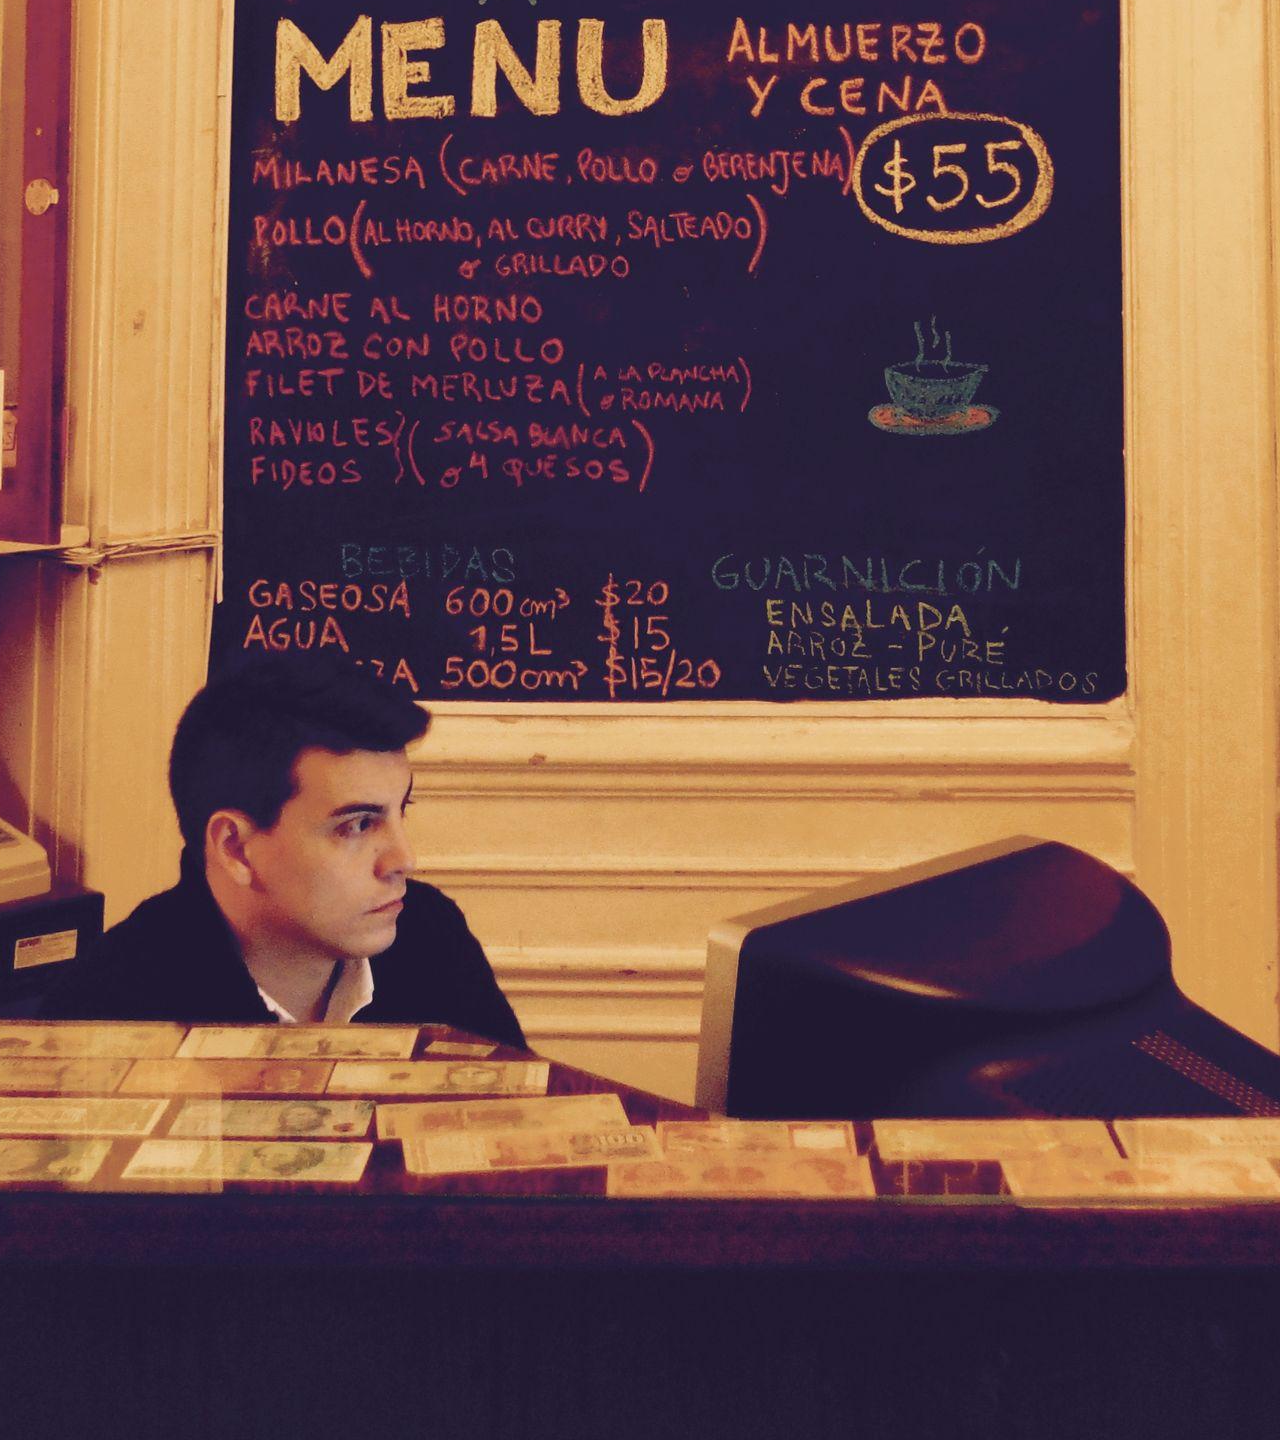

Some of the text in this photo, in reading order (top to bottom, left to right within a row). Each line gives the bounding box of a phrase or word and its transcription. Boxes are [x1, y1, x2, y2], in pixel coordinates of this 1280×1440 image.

[727, 16, 986, 64] ALMUERZO
[275, 14, 668, 123] MENU
[746, 75, 948, 118] Y CENA
[253, 155, 426, 190] MILANESA
[577, 147, 658, 184] POLLO
[874, 139, 1024, 214] $55
[254, 215, 347, 246] POLLO
[488, 218, 519, 241] AL
[495, 252, 630, 278] GRILLADO
[244, 293, 544, 325] CARNE AL HORNO
[246, 332, 565, 363] ARROZ CON POLLO
[246, 368, 345, 398] FILET
[357, 370, 393, 399] DE
[412, 372, 571, 406] MERLUZA
[619, 365, 641, 381] LA
[620, 387, 724, 413] ROMANA
[249, 416, 393, 447] RAVIOLES
[251, 455, 363, 491] FIDEOS
[470, 450, 488, 479] 4
[341, 543, 516, 583] BEBIDAS
[248, 578, 411, 618] GASEOSA
[766, 599, 972, 636] ENSALADA
[243, 613, 350, 654] AGUA
[767, 625, 872, 660] ARROZ
[761, 665, 1099, 695] VEGETALES GRILLADOS
